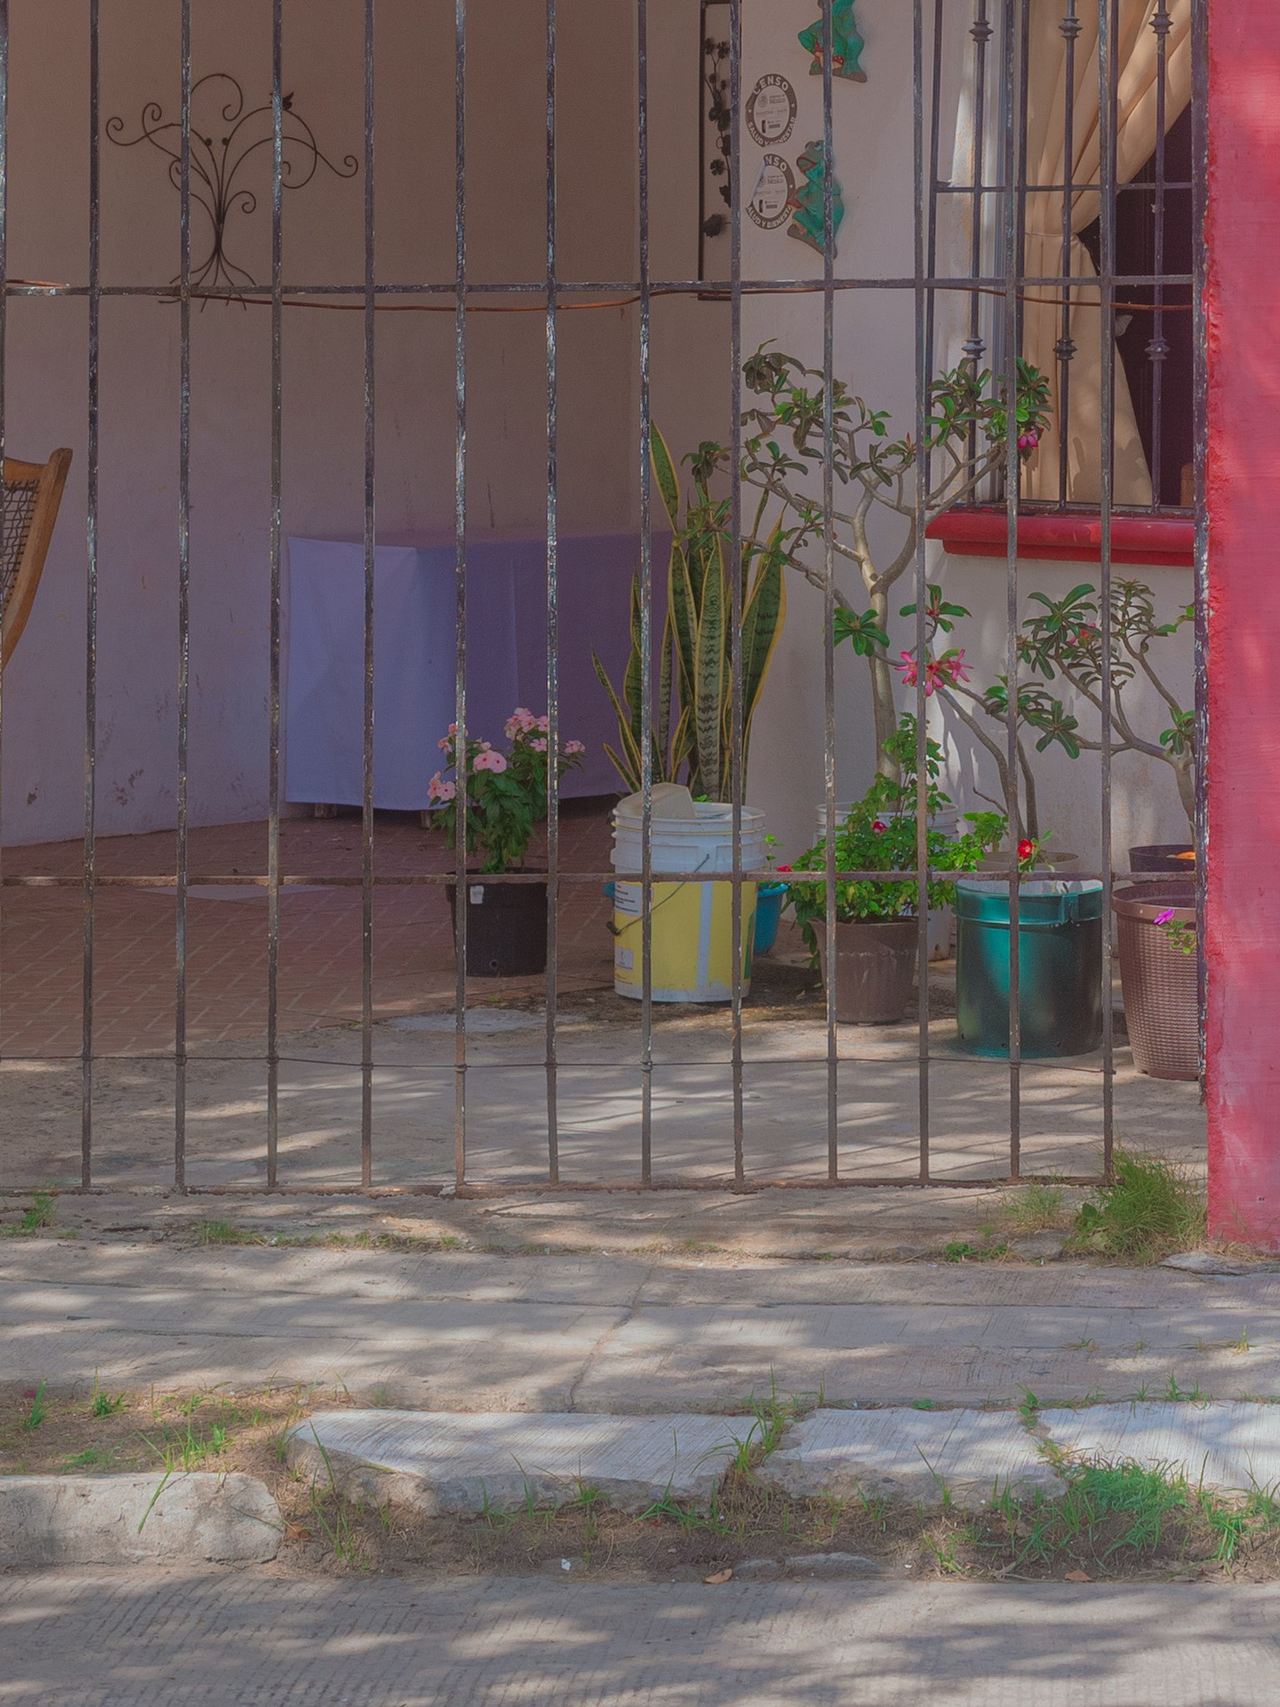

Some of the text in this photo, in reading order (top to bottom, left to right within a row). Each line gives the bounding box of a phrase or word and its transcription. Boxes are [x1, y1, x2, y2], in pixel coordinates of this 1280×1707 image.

[753, 75, 789, 94] CENSO
[747, 122, 765, 145] SALUD
[764, 155, 787, 172] NSO
[747, 206, 761, 225] ALUD
